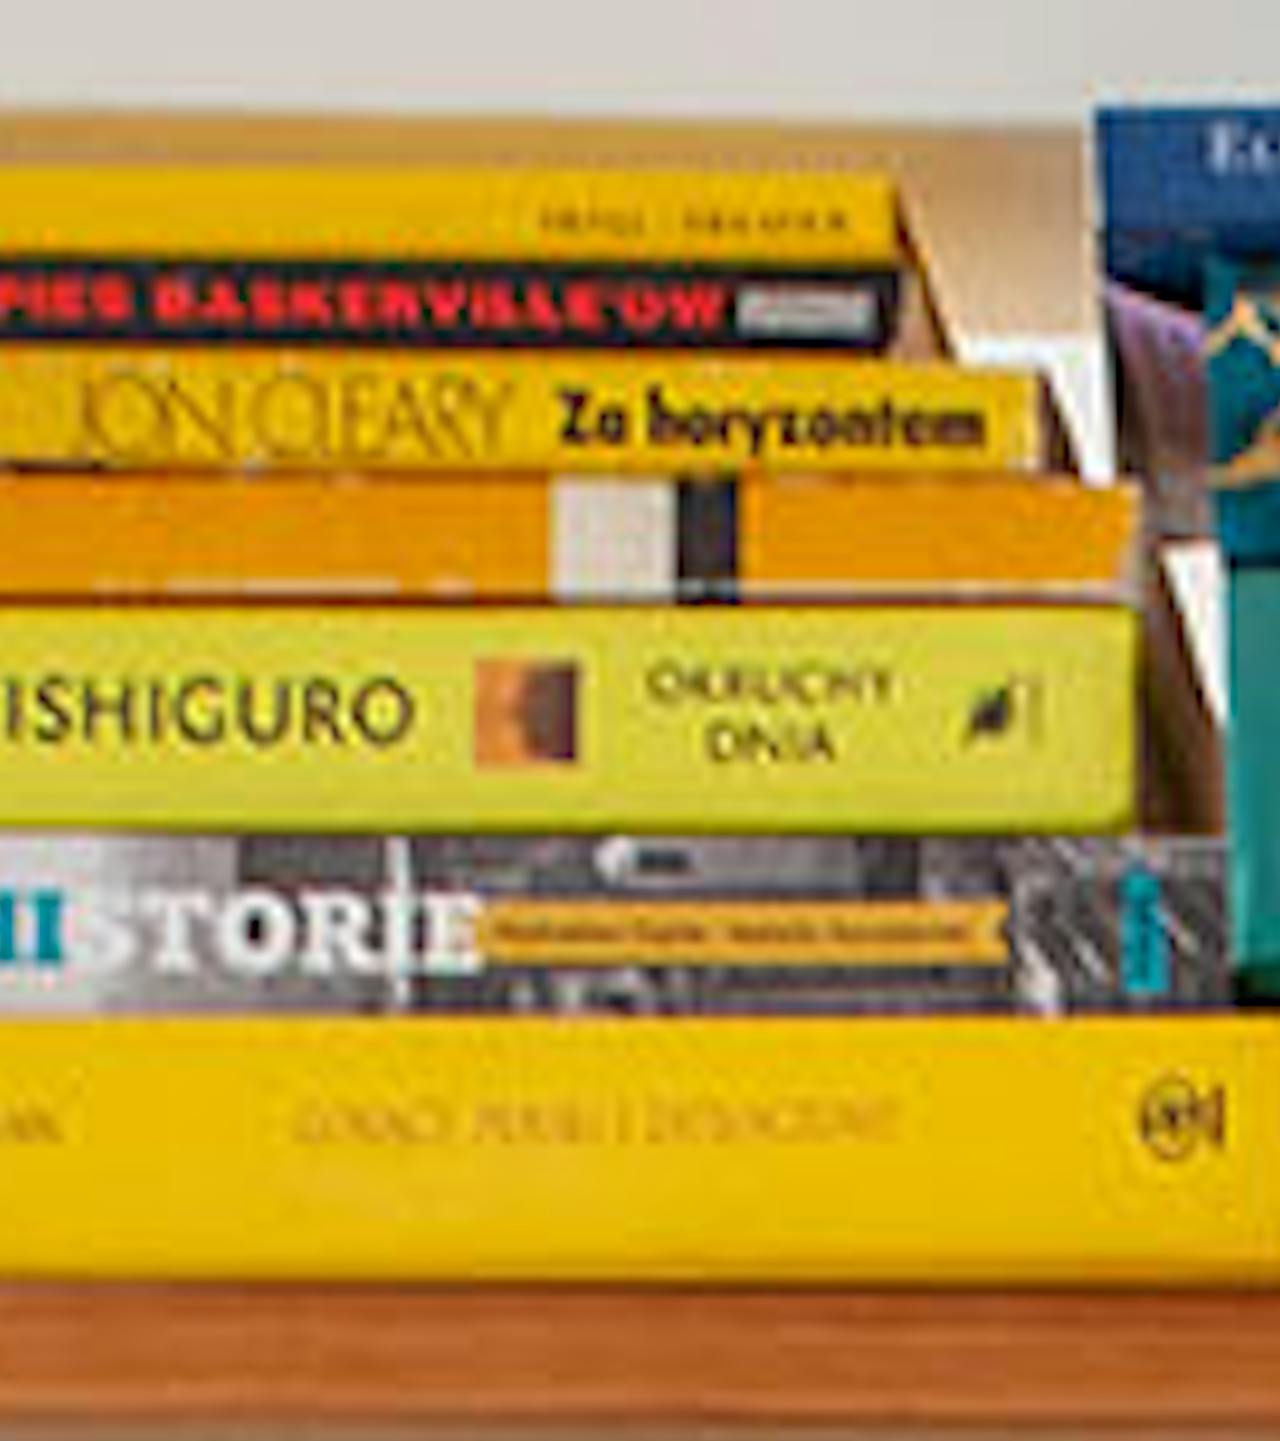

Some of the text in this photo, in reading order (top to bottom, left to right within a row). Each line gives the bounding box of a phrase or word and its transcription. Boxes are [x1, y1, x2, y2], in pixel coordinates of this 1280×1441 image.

[556, 385, 628, 446] Za
[647, 384, 987, 459] horyzontem
[5, 674, 417, 747] ISHIGURO
[645, 662, 892, 707] OKRUCHY
[708, 723, 837, 765] DNIA
